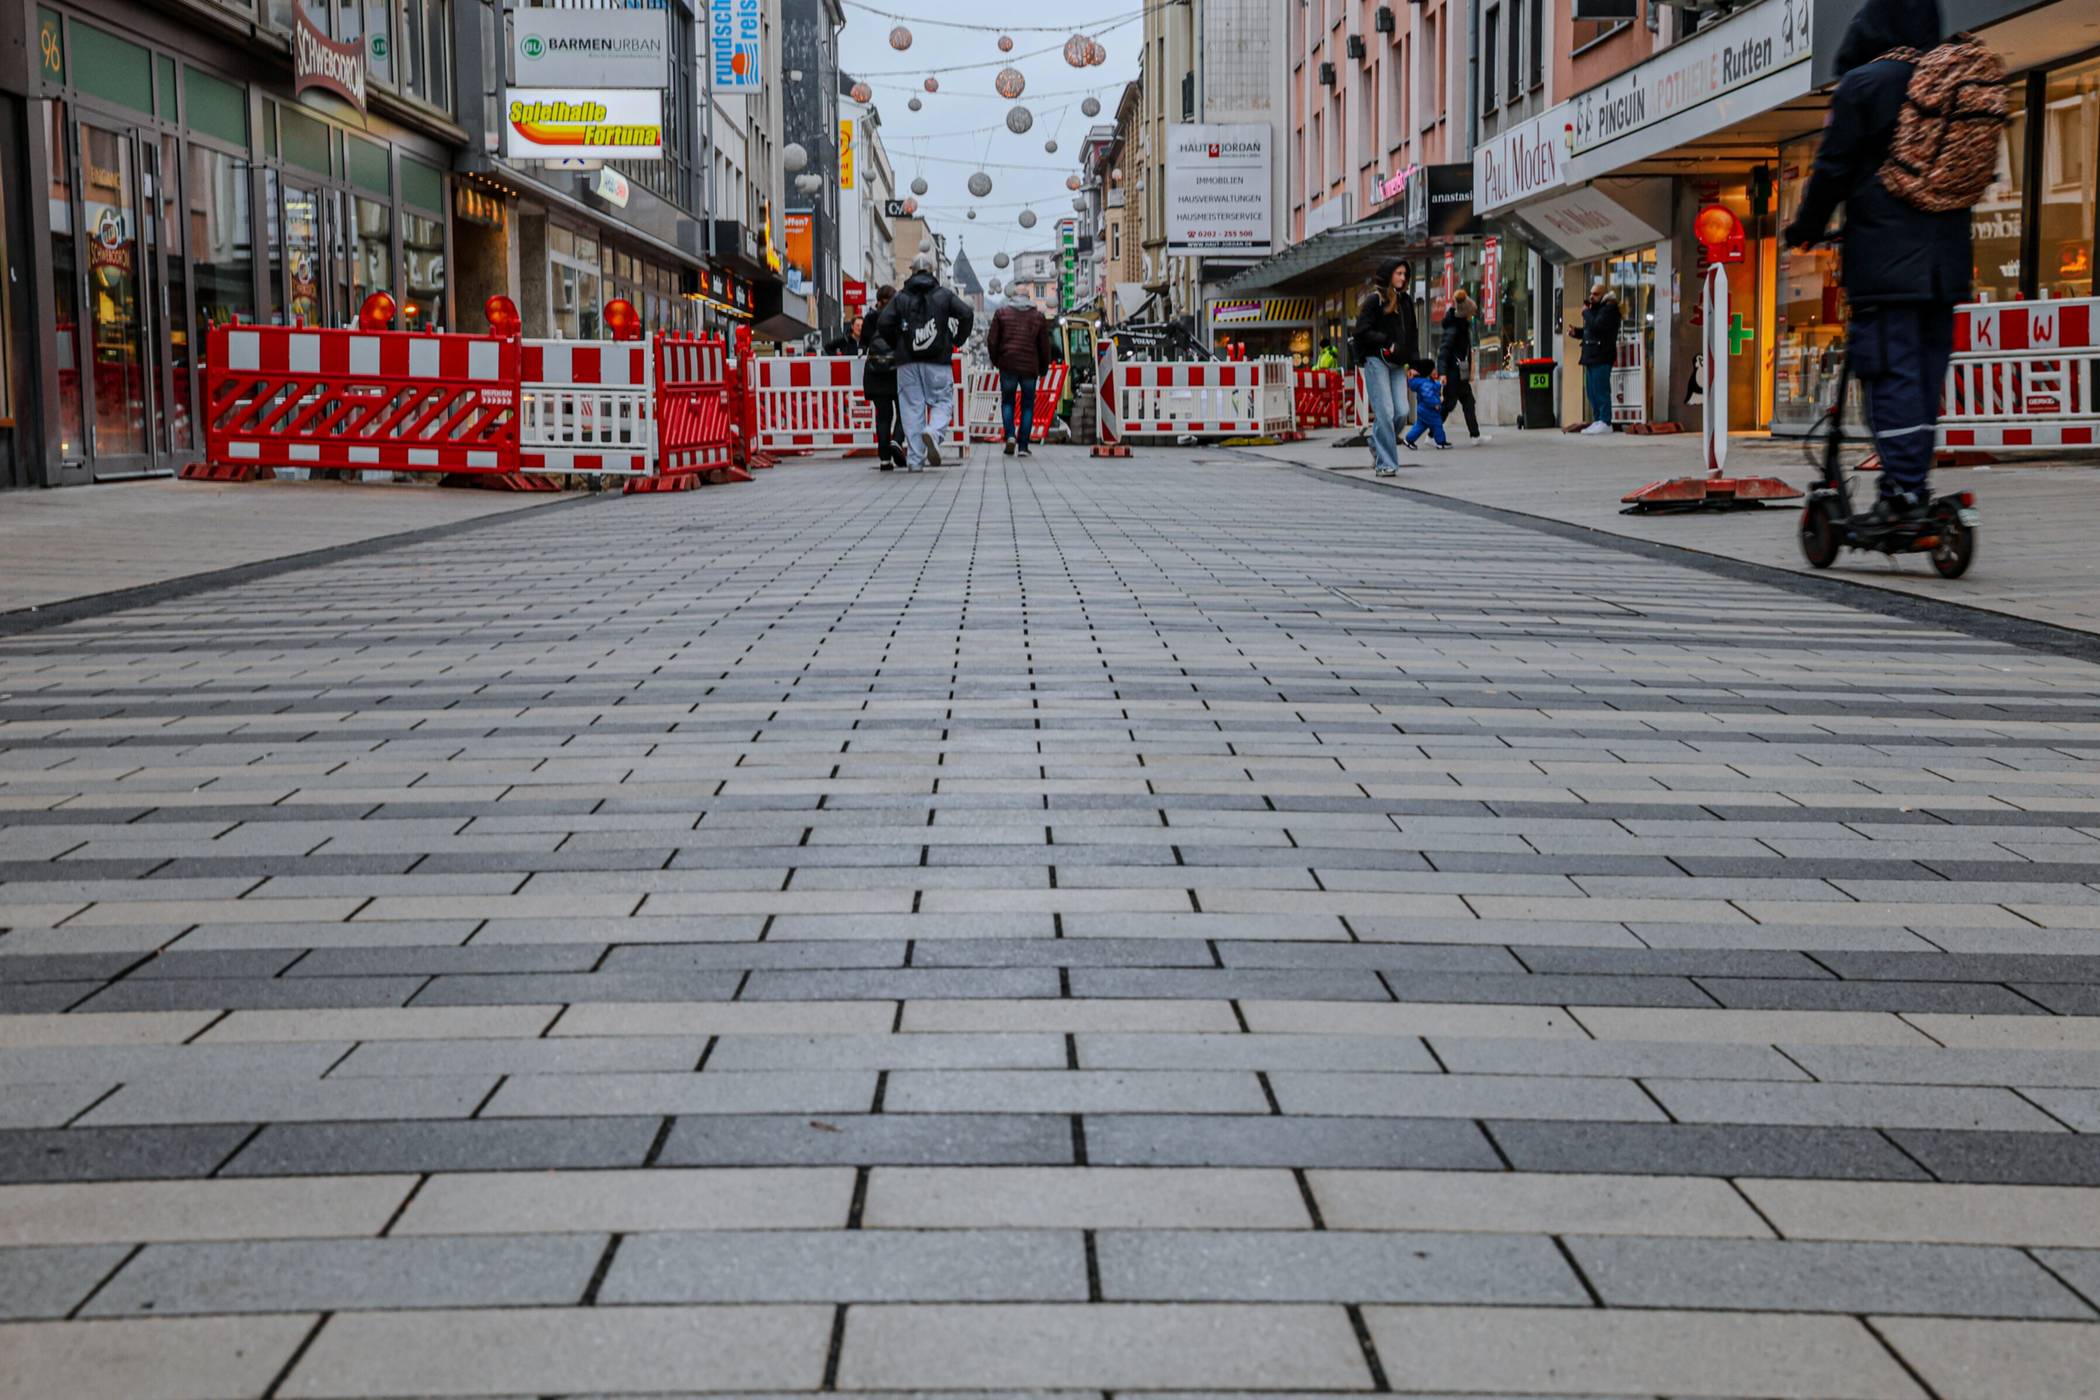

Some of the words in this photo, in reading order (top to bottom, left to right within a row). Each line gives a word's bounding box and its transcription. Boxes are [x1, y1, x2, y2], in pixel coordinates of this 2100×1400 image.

[41, 29, 60, 72] 96
[549, 38, 661, 51] BARMENURBAN
[297, 20, 365, 108] SCHWEBODROM
[1723, 36, 1772, 84] Rutten
[509, 101, 607, 124] Spielhalle
[583, 125, 658, 146] Fortuna
[1180, 143, 1207, 153] HAUT
[1221, 142, 1261, 153] JORDAN
[1196, 176, 1244, 185] IMMOBILIEN
[1178, 194, 1262, 203] HAUSVERWALTUNGEN
[1176, 213, 1263, 221] HAUSMEISTERSERVICE
[915, 319, 937, 344] NIKE
[1977, 316, 1992, 347] K
[2033, 314, 2052, 342] W
[1132, 338, 1157, 346] VOLVO
[1533, 376, 1546, 385] 50
